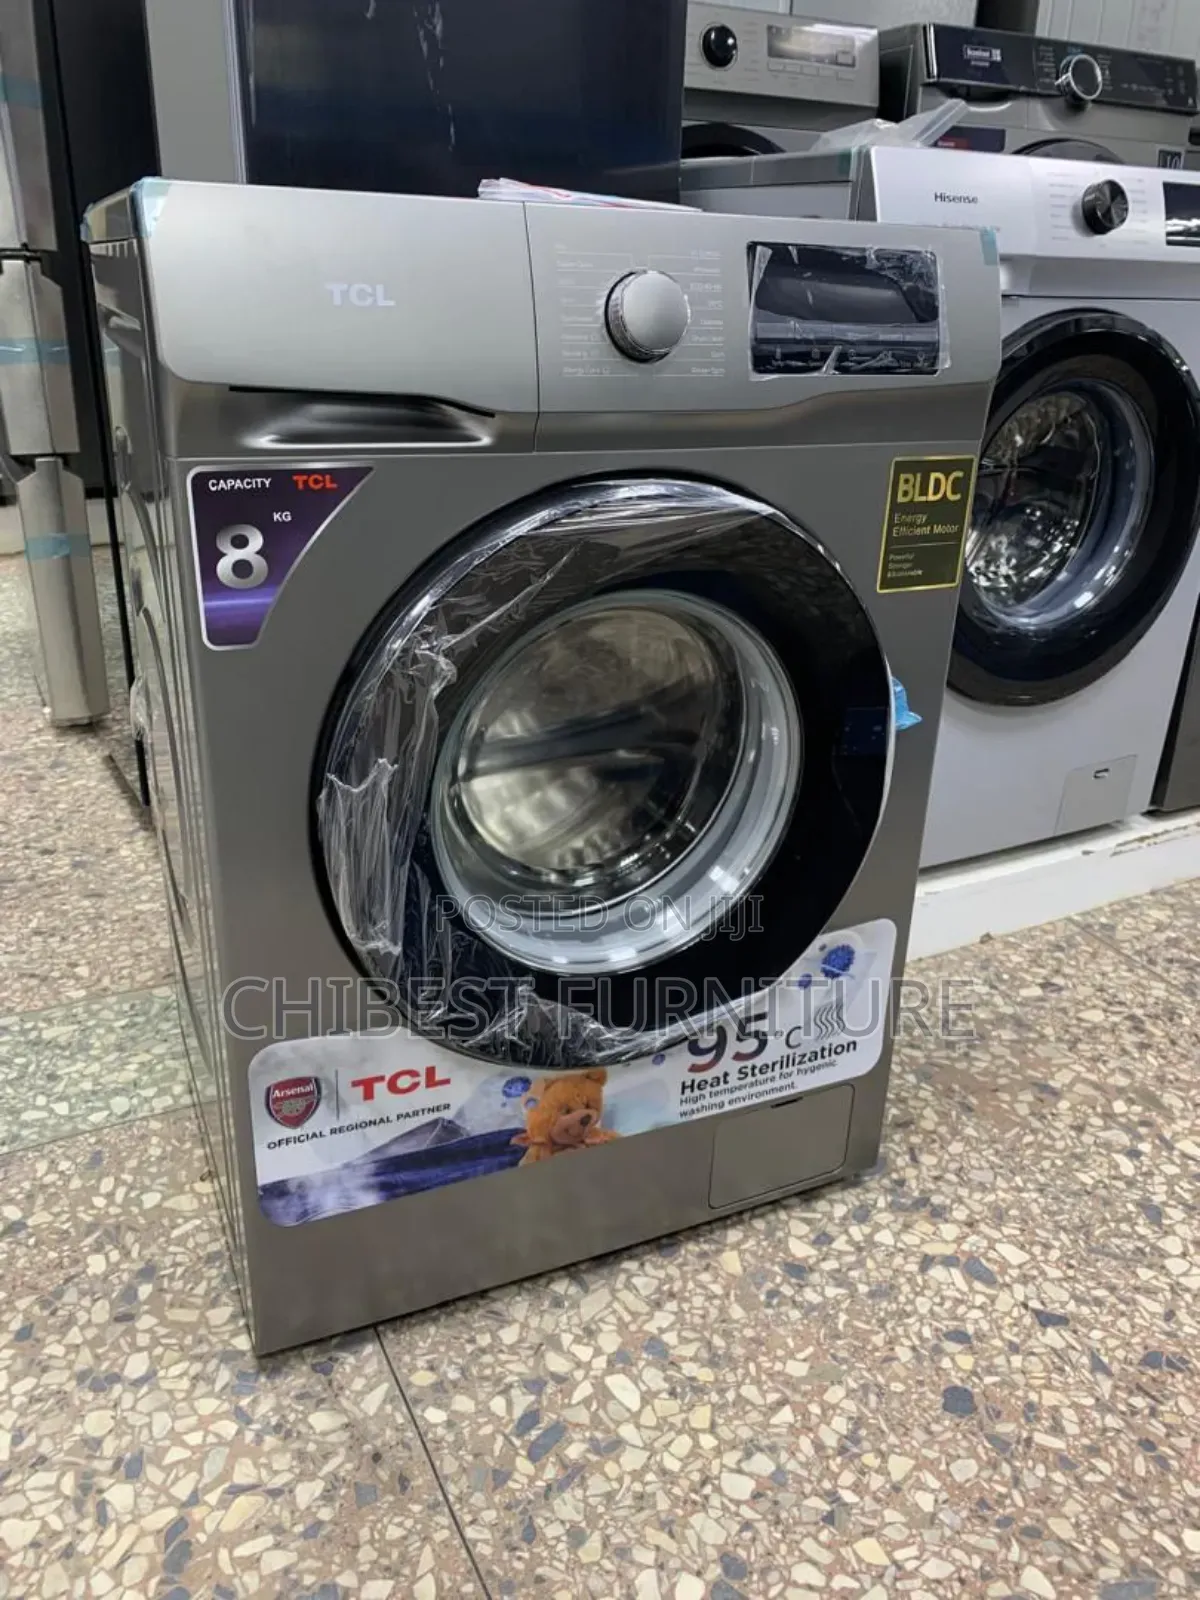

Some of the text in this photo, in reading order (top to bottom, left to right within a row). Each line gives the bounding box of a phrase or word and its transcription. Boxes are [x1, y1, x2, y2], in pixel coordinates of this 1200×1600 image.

[934, 191, 979, 204] Hisense
[324, 282, 396, 307] TCL
[208, 474, 337, 491] CAPACITY TCL
[897, 470, 964, 503] BLDC
[273, 511, 292, 522] KG
[895, 513, 928, 524] Energy
[893, 523, 958, 537] Efficient Motor
[215, 524, 269, 589] 8
[681, 1040, 857, 1095] Heat Sterilization
[272, 1083, 315, 1099] Arsenal
[351, 1066, 451, 1102] TCL
[679, 1091, 706, 1107] High
[709, 1074, 776, 1098] temperature
[778, 1069, 794, 1081] for
[679, 1100, 725, 1118] washing
[267, 1103, 451, 1150] OFFICIAL REGIONAL PARTNER
